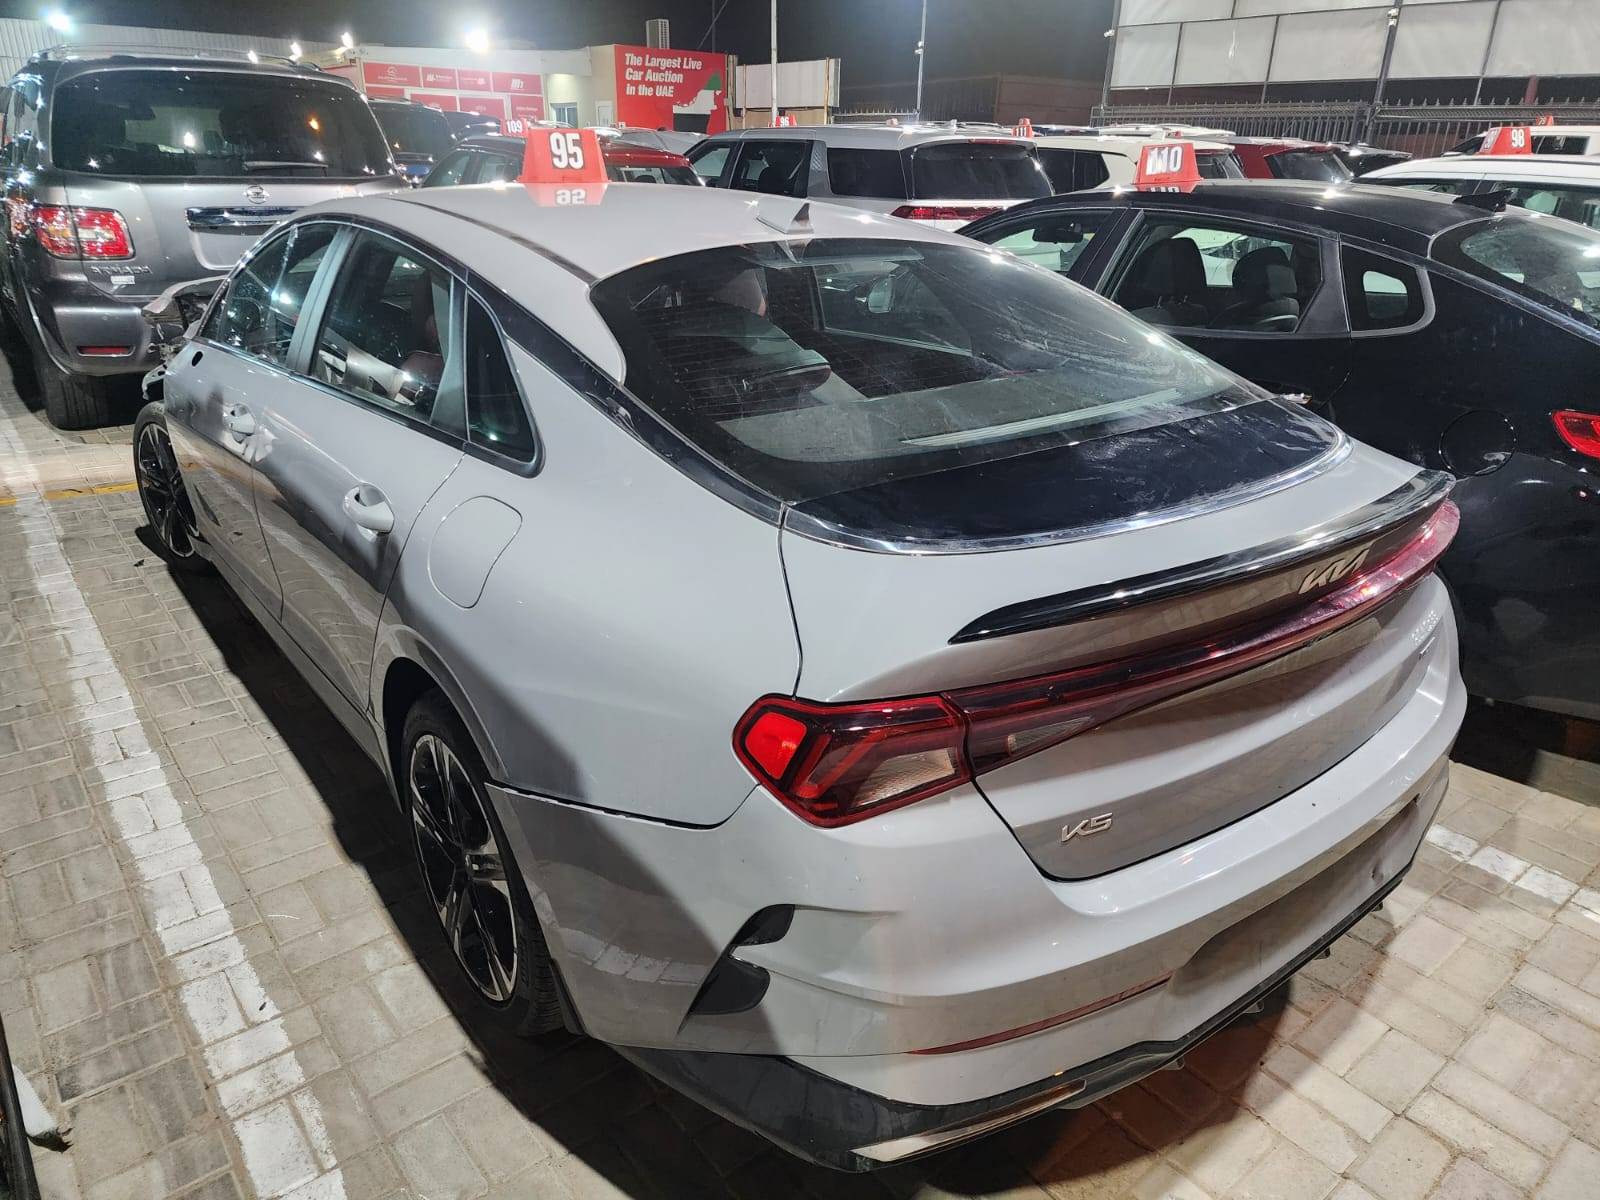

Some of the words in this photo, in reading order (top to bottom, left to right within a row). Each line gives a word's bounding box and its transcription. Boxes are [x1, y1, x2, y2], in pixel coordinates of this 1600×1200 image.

[625, 53, 642, 66] The
[645, 54, 681, 69] Largest
[683, 57, 702, 70] Live
[625, 67, 644, 81] Car
[645, 69, 683, 83] Auction
[626, 83, 636, 96] in
[638, 84, 653, 96] the
[655, 85, 674, 97] UAE
[506, 120, 523, 134] 109
[1016, 127, 1027, 136] 111
[1511, 128, 1525, 148] 98
[549, 131, 584, 169] 95
[1061, 812, 1113, 842] K5
